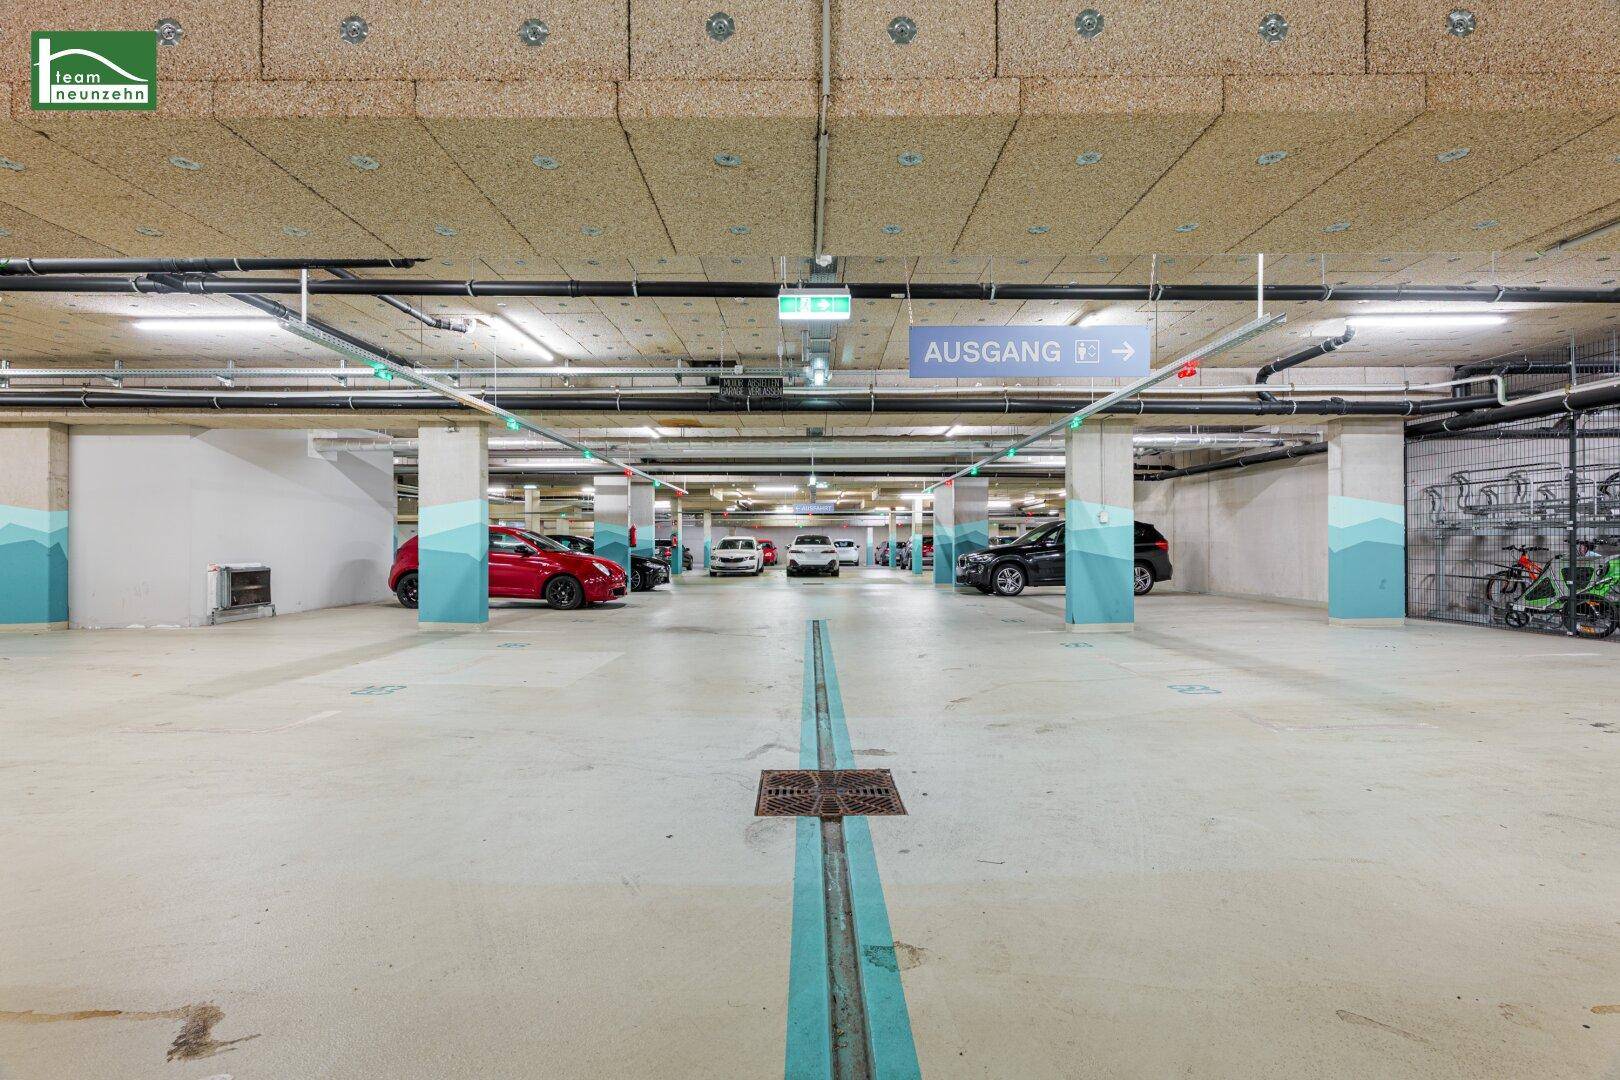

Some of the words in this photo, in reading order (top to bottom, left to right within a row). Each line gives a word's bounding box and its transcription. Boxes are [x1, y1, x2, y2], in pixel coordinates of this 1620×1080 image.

[924, 340, 1061, 363] AUSGANG
[723, 378, 744, 387] MOTOR
[720, 387, 743, 396] GARAGE
[801, 504, 832, 512] AUSFAHRT
